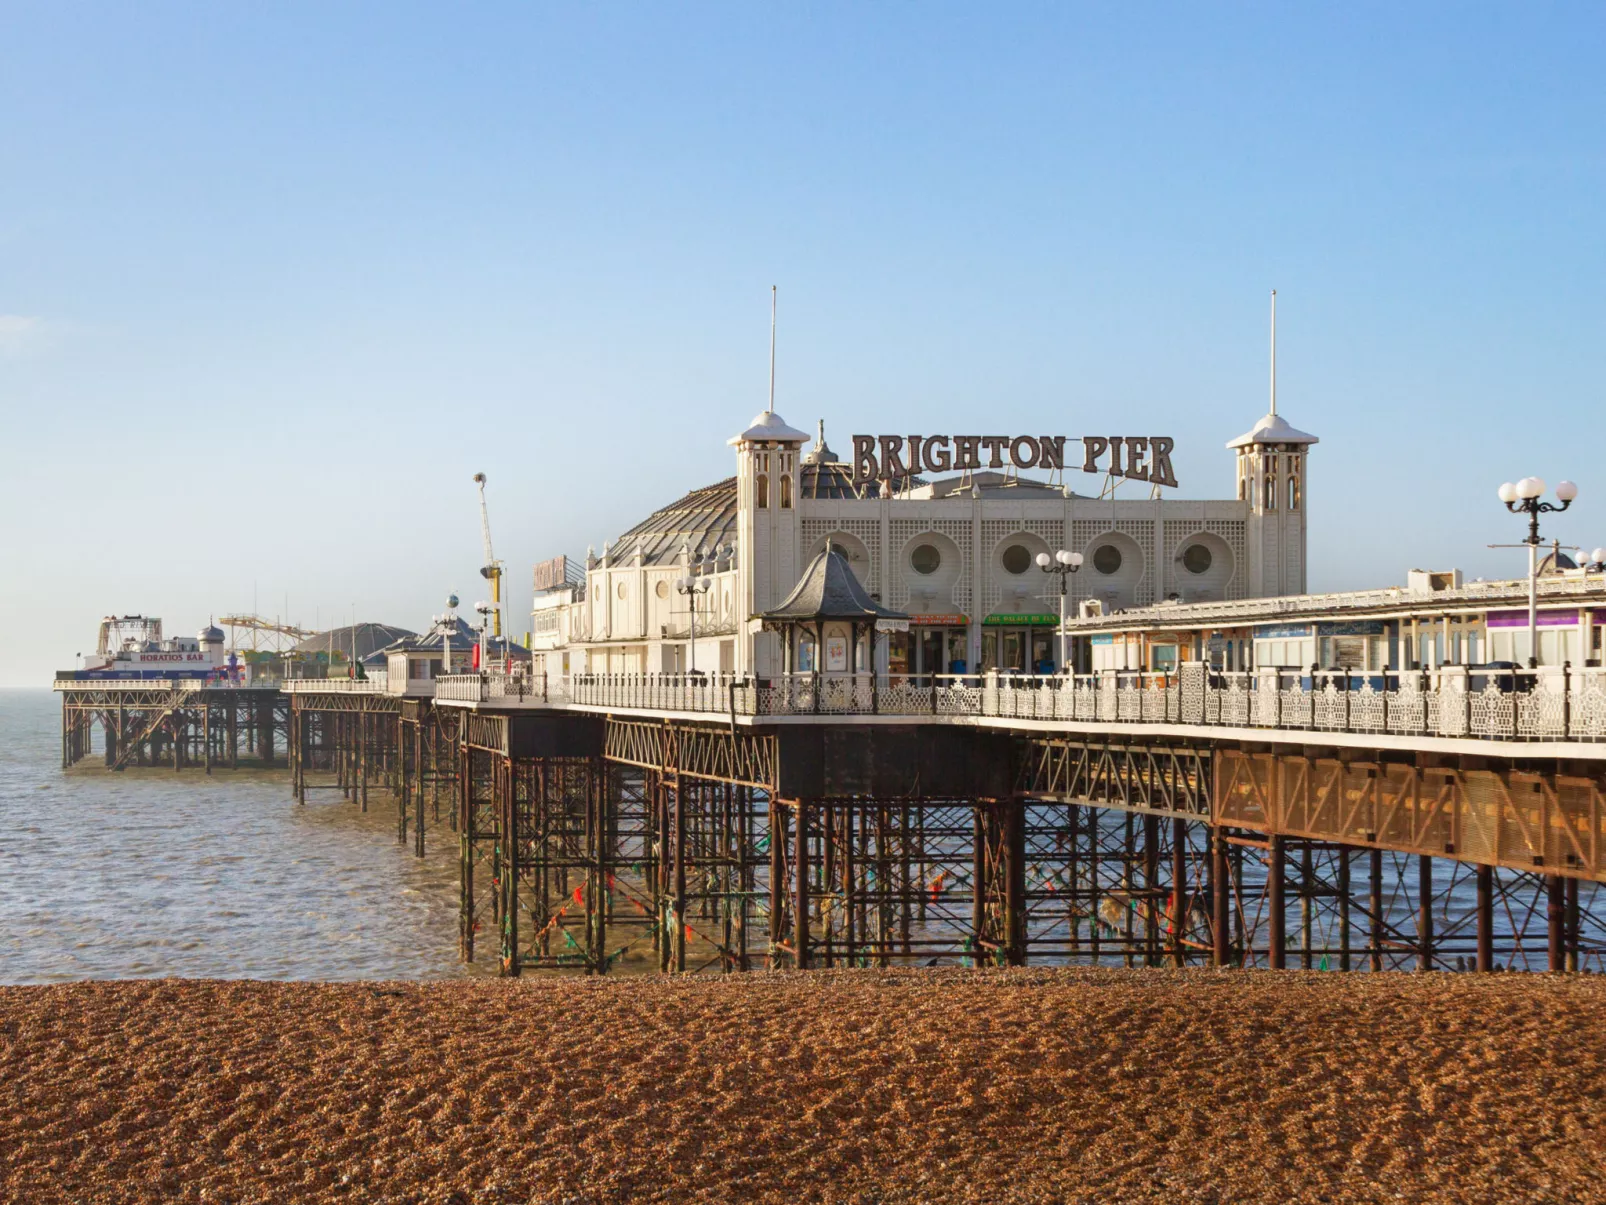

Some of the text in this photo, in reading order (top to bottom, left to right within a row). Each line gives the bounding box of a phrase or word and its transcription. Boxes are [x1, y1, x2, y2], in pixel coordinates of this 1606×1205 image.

[852, 435, 1179, 488] BRIGHTON PIER
[140, 654, 183, 662] HORATIOS
